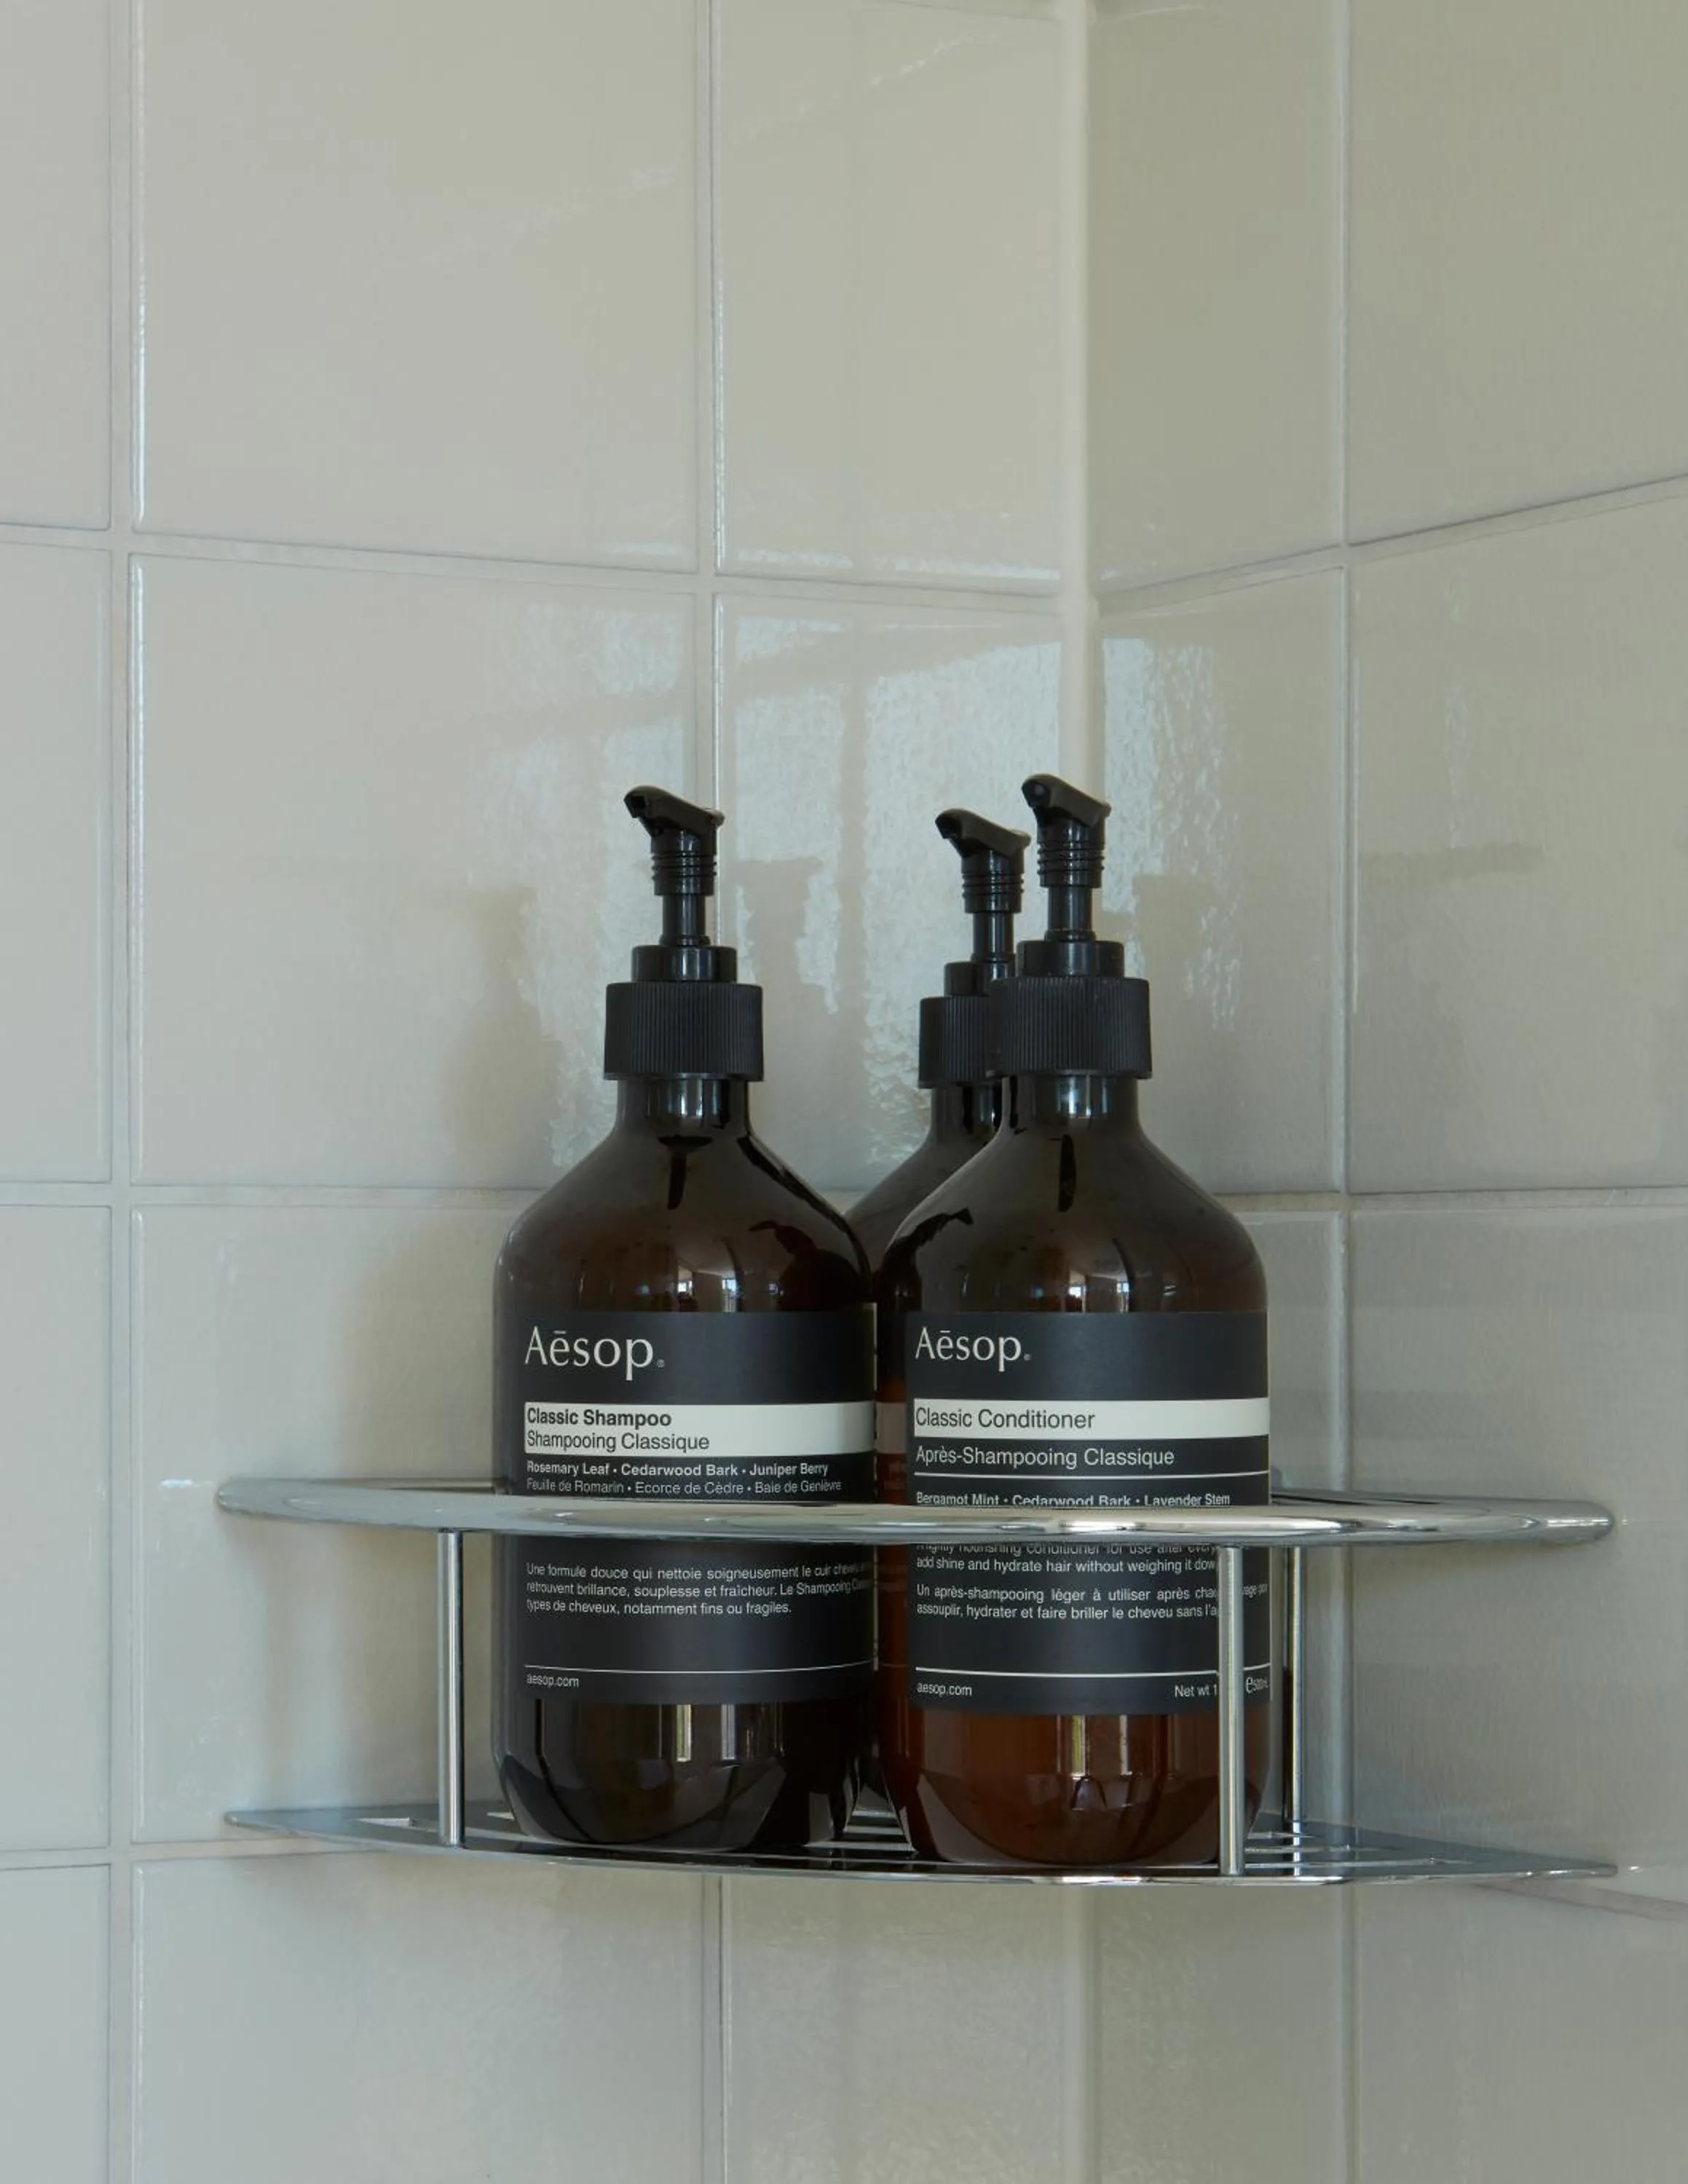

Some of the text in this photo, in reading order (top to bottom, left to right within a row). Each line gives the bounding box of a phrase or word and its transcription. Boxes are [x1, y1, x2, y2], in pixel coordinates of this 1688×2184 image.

[527, 1407, 671, 1430] Classic Shampoo
[916, 1407, 1095, 1429] Classic Conditioner
[527, 1431, 709, 1453] Shampooing Classique
[916, 1445, 1077, 1469] Après-Shampooing
[1084, 1448, 1175, 1469] Classique
[527, 1461, 828, 1479] Rosemary Leaf Cedarwood Bark Juniper Berry
[559, 1481, 571, 1492] de
[575, 1481, 623, 1493] Romarin
[636, 1482, 680, 1495] Ecorce
[684, 1482, 701, 1495] de
[704, 1481, 743, 1495] Cèdre
[755, 1481, 781, 1494] Baie
[784, 1481, 797, 1493] de
[917, 1492, 1230, 1506] Bergamot Mint Cedarwood Bark Lavender Stem
[1129, 1544, 1151, 1555] use
[527, 1563, 545, 1575] Une
[547, 1564, 586, 1576] formule
[591, 1566, 628, 1578] douce
[633, 1567, 652, 1581] qui
[658, 1568, 701, 1579] nettoie
[707, 1567, 799, 1582] soigneusement
[802, 1565, 811, 1577] le
[917, 1556, 934, 1569] add
[936, 1556, 964, 1570] shine
[969, 1559, 989, 1571] and
[994, 1559, 1042, 1574] hydrate
[1046, 1559, 1070, 1572] hair
[1076, 1559, 1123, 1572] without
[1128, 1559, 1181, 1574] weighing
[1185, 1557, 1194, 1570] it
[1196, 1557, 1218, 1570] dow
[527, 1582, 574, 1595] retrouvent
[577, 1584, 630, 1598] brillance,
[635, 1585, 700, 1599] souplesse
[704, 1586, 717, 1597] et
[720, 1583, 777, 1597] fraîcheur.
[781, 1583, 792, 1596] Le
[797, 1579, 851, 1597] Shampooing
[917, 1584, 930, 1596] Un
[934, 1586, 1044, 1603] après-shampooing
[1052, 1588, 1085, 1604] léger
[1093, 1588, 1101, 1601] à
[1108, 1588, 1150, 1601] utiliser
[1157, 1587, 1190, 1603] après
[527, 1599, 792, 1617] types de cheveux, notamment fins ou fragiles.
[917, 1603, 963, 1618] assouplir,
[967, 1606, 1017, 1621] hydrater
[1021, 1608, 1033, 1619] et
[1037, 1607, 1066, 1619] faire
[1071, 1607, 1107, 1619] briller
[1112, 1607, 1123, 1619] le
[1128, 1607, 1172, 1619] cheveu
[1176, 1607, 1202, 1618] sans
[527, 1674, 579, 1688] aesop.com
[917, 1682, 972, 1697] aesop.com
[1175, 1685, 1196, 1698] Net
[1197, 1684, 1210, 1696] wt
